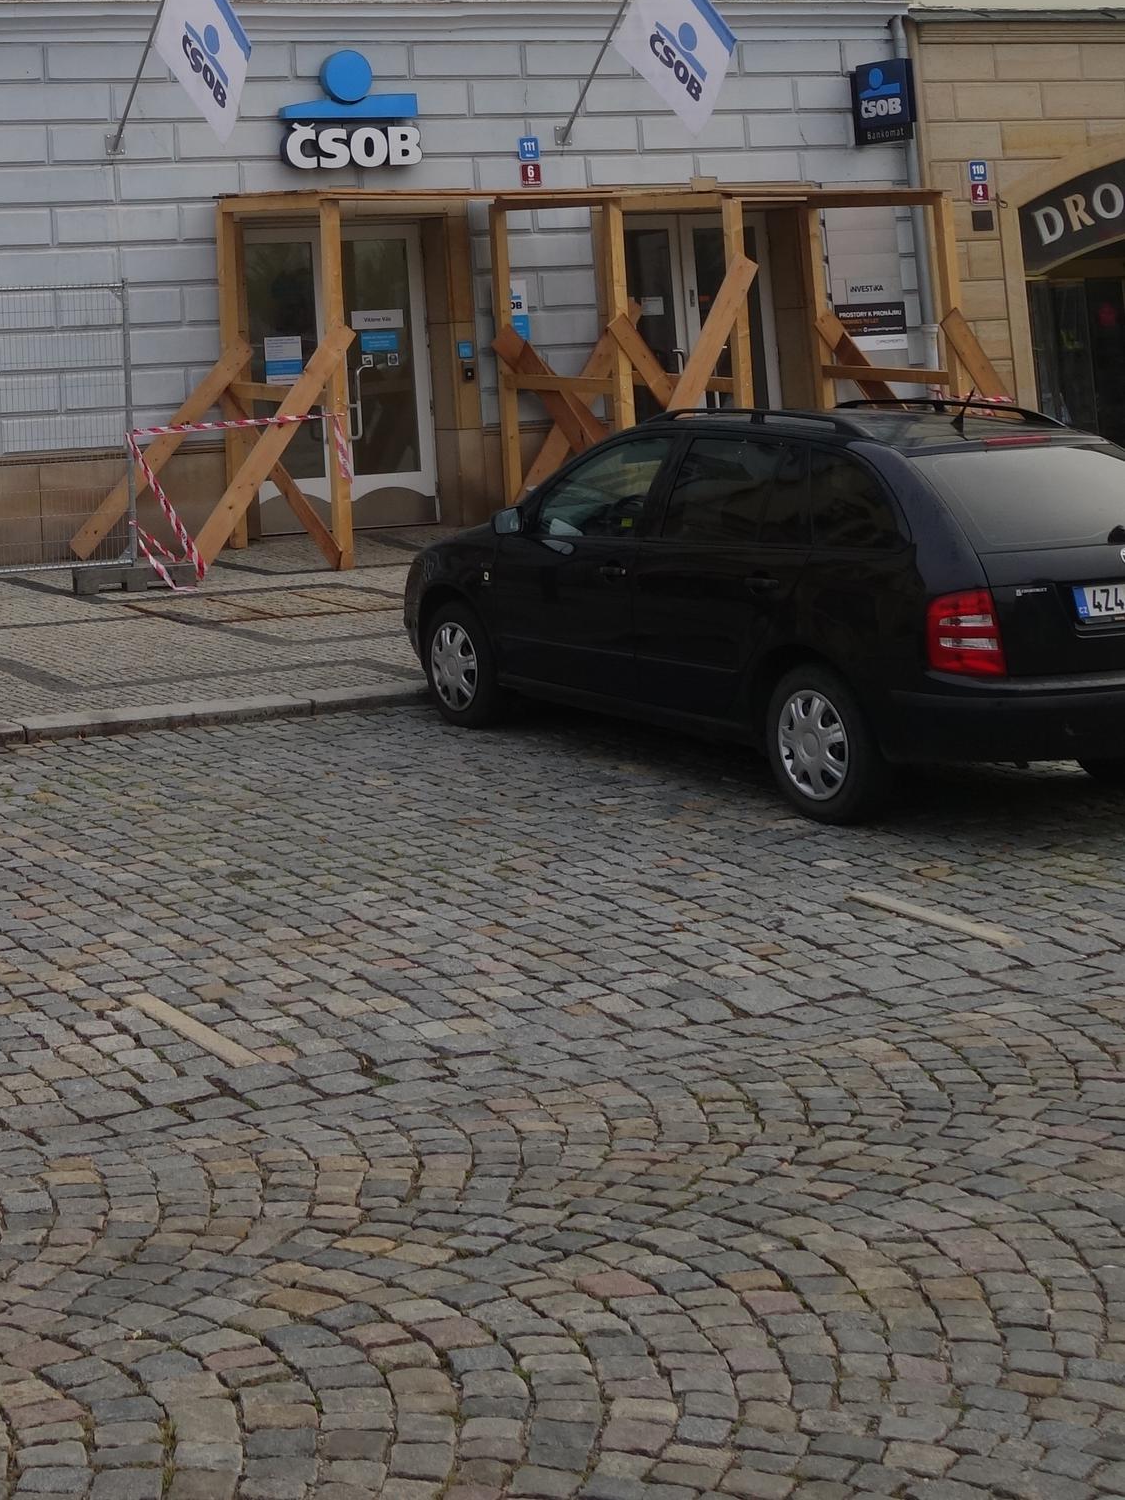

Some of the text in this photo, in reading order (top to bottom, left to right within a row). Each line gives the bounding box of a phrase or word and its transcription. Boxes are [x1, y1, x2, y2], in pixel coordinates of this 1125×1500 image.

[182, 31, 227, 109] ČSOB
[649, 30, 703, 102] ČSOB
[861, 97, 902, 119] ČSOB
[867, 127, 905, 140] Bankomat
[286, 122, 423, 169] ČSOB
[523, 141, 536, 152] 111
[527, 165, 535, 178] 6
[972, 164, 985, 175] 110
[976, 185, 984, 197] 4
[1031, 182, 1125, 246] DRO
